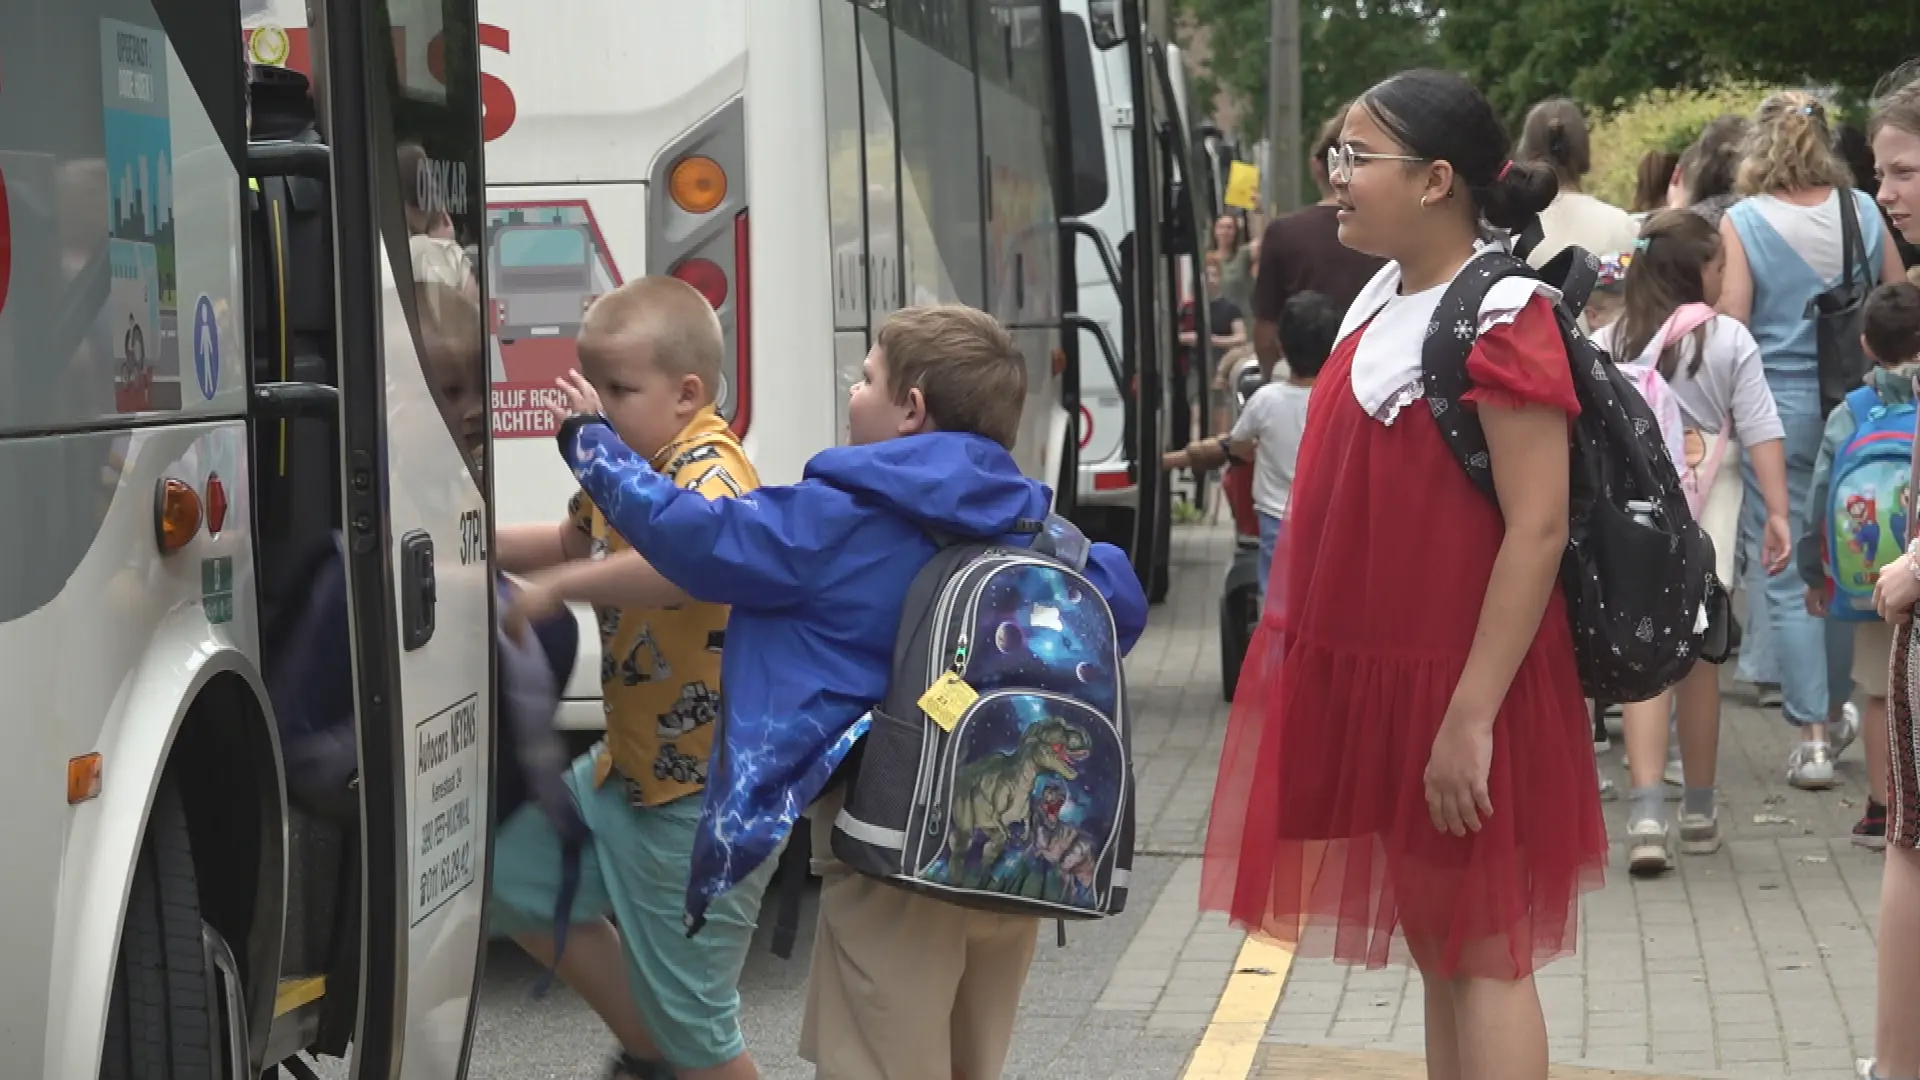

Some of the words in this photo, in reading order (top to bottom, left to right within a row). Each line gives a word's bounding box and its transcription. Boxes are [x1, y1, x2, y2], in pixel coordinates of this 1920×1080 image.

[417, 157, 468, 215] OTOKAR
[491, 388, 527, 409] BLIJF
[530, 387, 569, 408] RECH
[492, 409, 555, 433] ACHTER
[460, 508, 486, 566] 37PL
[417, 731, 448, 776] Autocars
[450, 701, 475, 757] NEYENS
